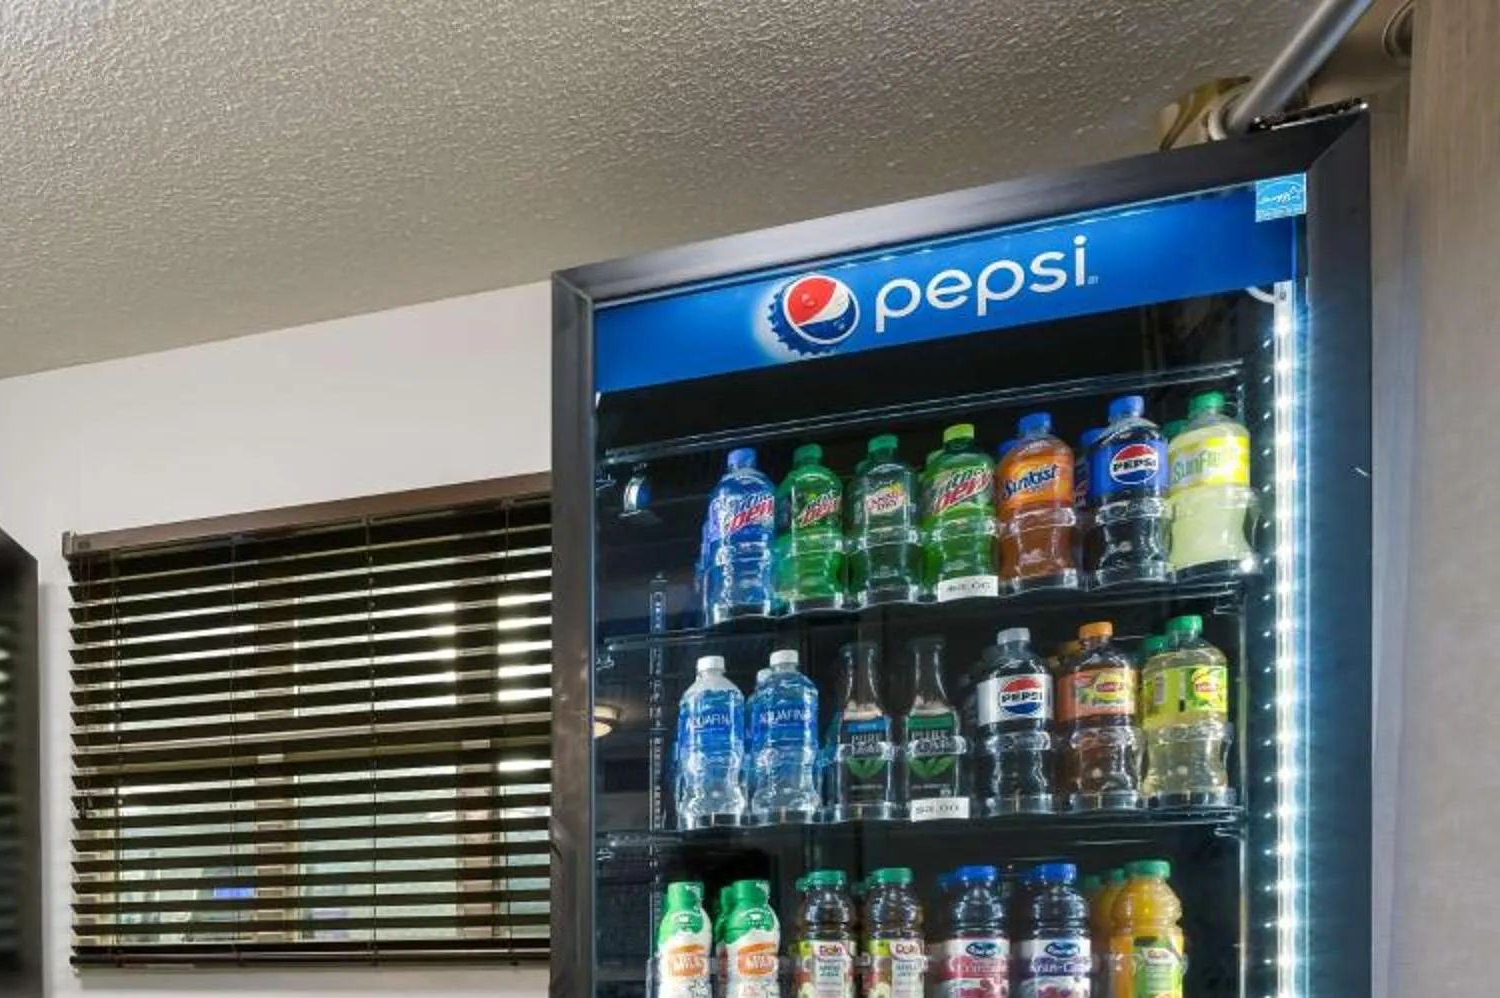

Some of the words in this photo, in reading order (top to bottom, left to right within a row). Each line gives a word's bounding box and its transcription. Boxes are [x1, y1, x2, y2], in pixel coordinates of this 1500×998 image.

[874, 235, 1089, 333] pepsi
[1112, 458, 1157, 474] PEPSI
[1004, 463, 1061, 497] Sunkist
[1001, 690, 1043, 702] PEPSI
